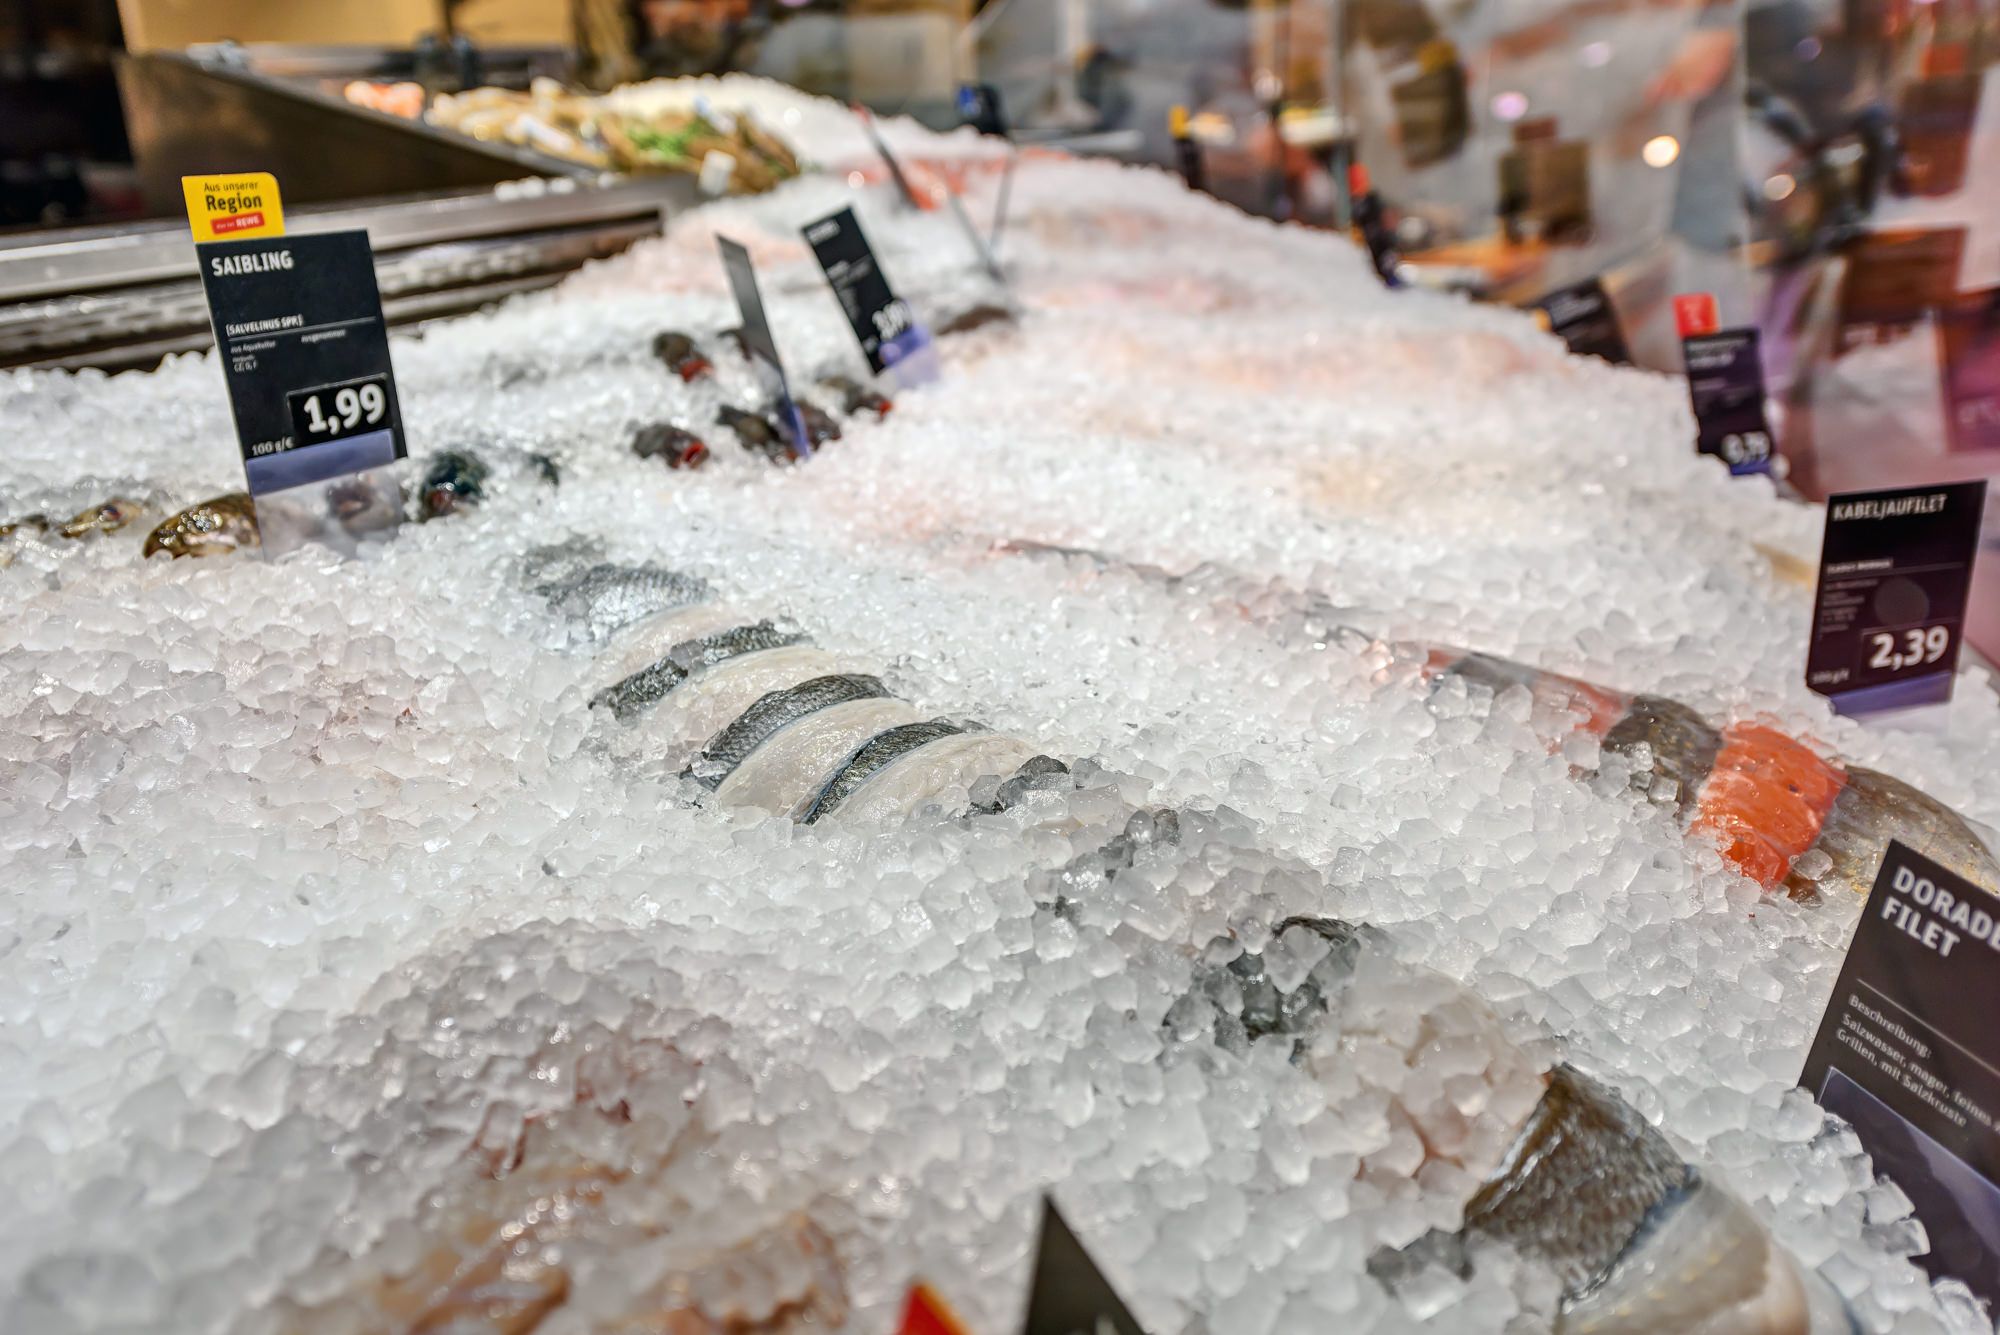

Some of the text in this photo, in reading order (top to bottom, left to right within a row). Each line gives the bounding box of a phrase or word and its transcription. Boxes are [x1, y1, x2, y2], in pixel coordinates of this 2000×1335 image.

[204, 182, 259, 192] Aus unserer
[205, 193, 262, 213] Region
[211, 250, 293, 276] SAIBLING
[304, 383, 385, 435] 1,99
[251, 440, 273, 456] 100
[1832, 494, 1948, 520] KABELJAUFILET
[1869, 625, 1949, 670] 2,39
[1881, 896, 1961, 957] FILET
[1849, 994, 1932, 1058] Beschreibung:
[1836, 1028, 1967, 1127] Grillen, mit Salzkruste
[1842, 1013, 1907, 1068] Salzwasser,
[1910, 1061, 1950, 1098] mager,
